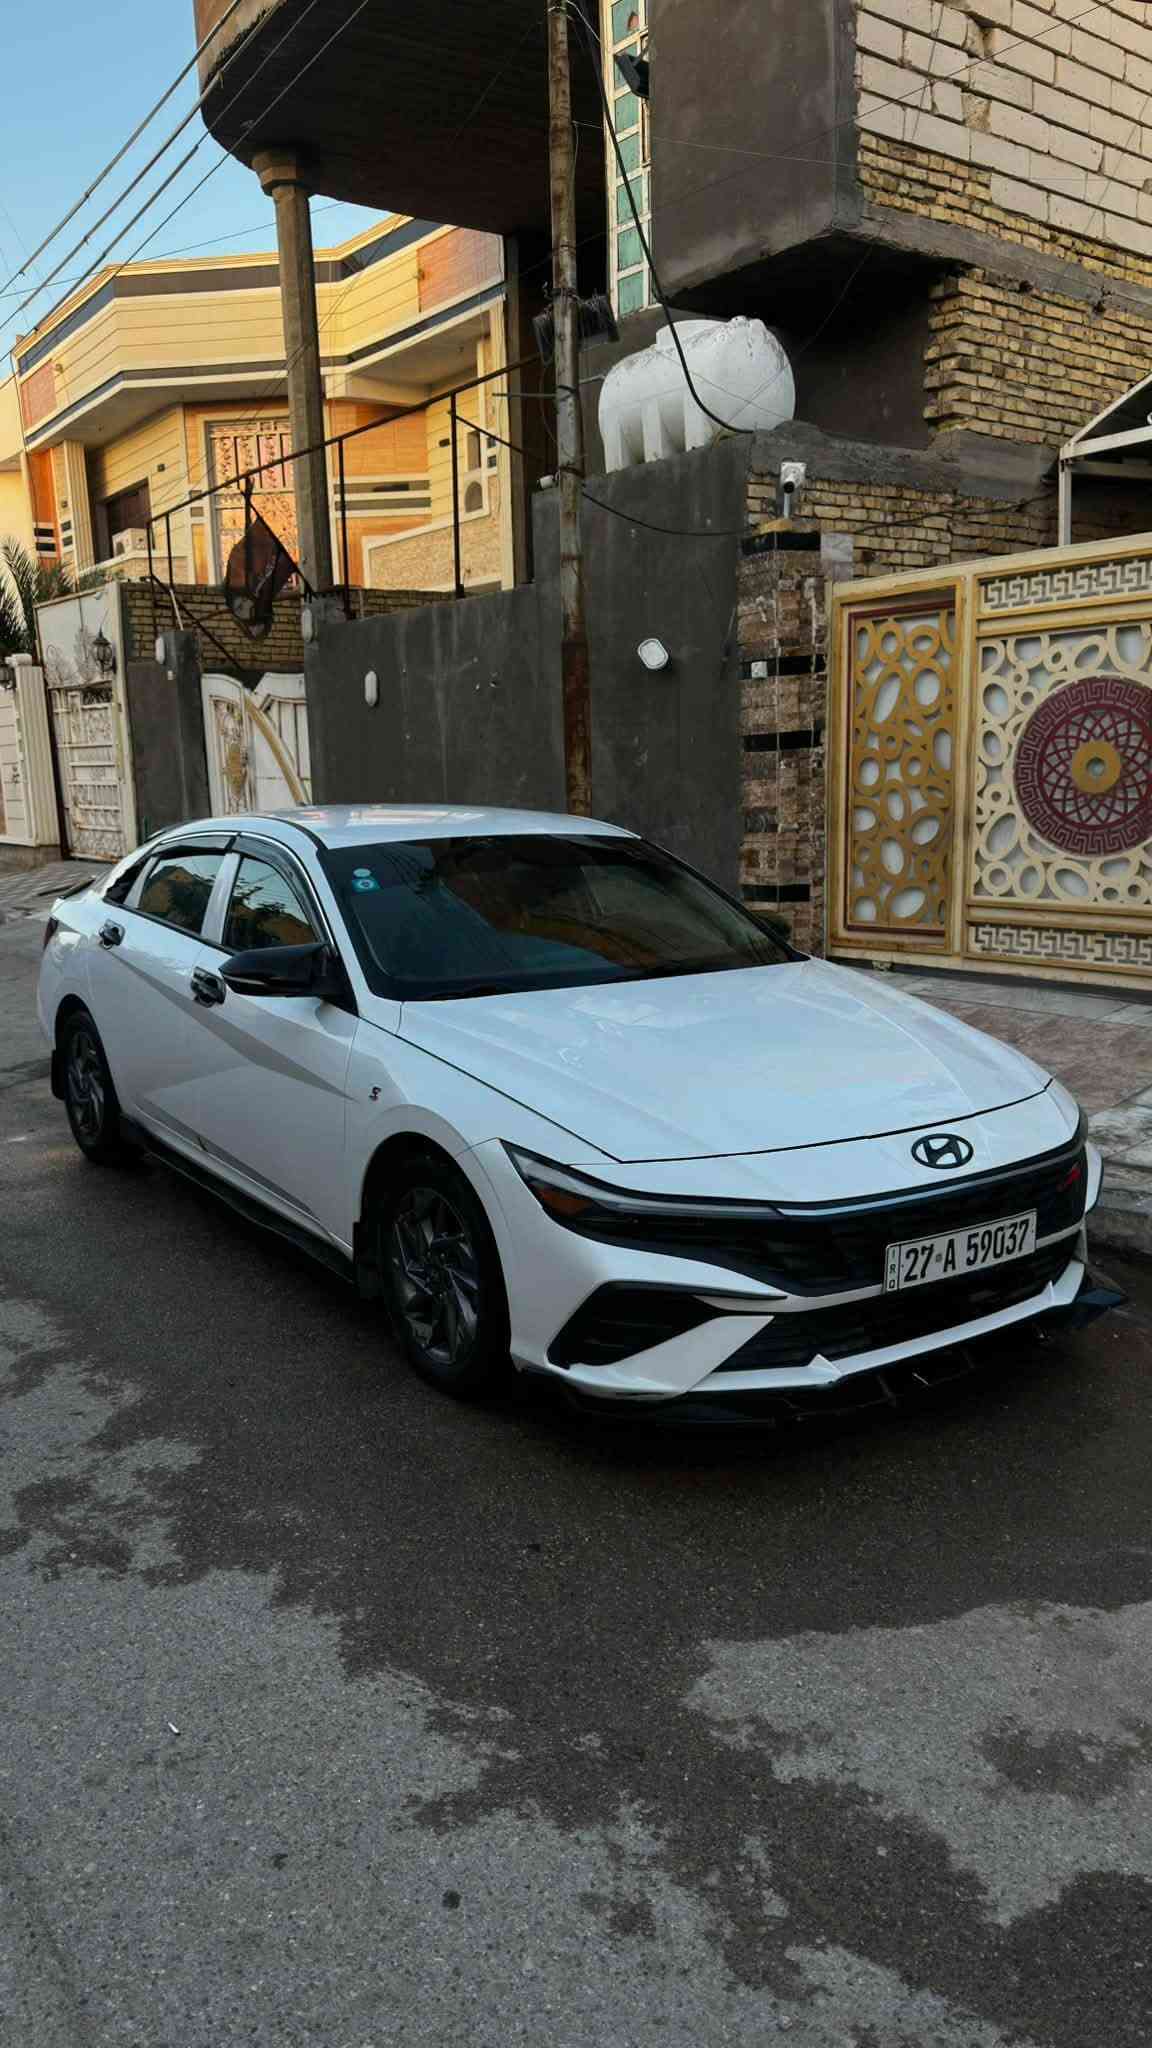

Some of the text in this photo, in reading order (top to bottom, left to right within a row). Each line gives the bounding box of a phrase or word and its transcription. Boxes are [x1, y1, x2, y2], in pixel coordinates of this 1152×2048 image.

[904, 1219, 1029, 1282] 27 A 59037
